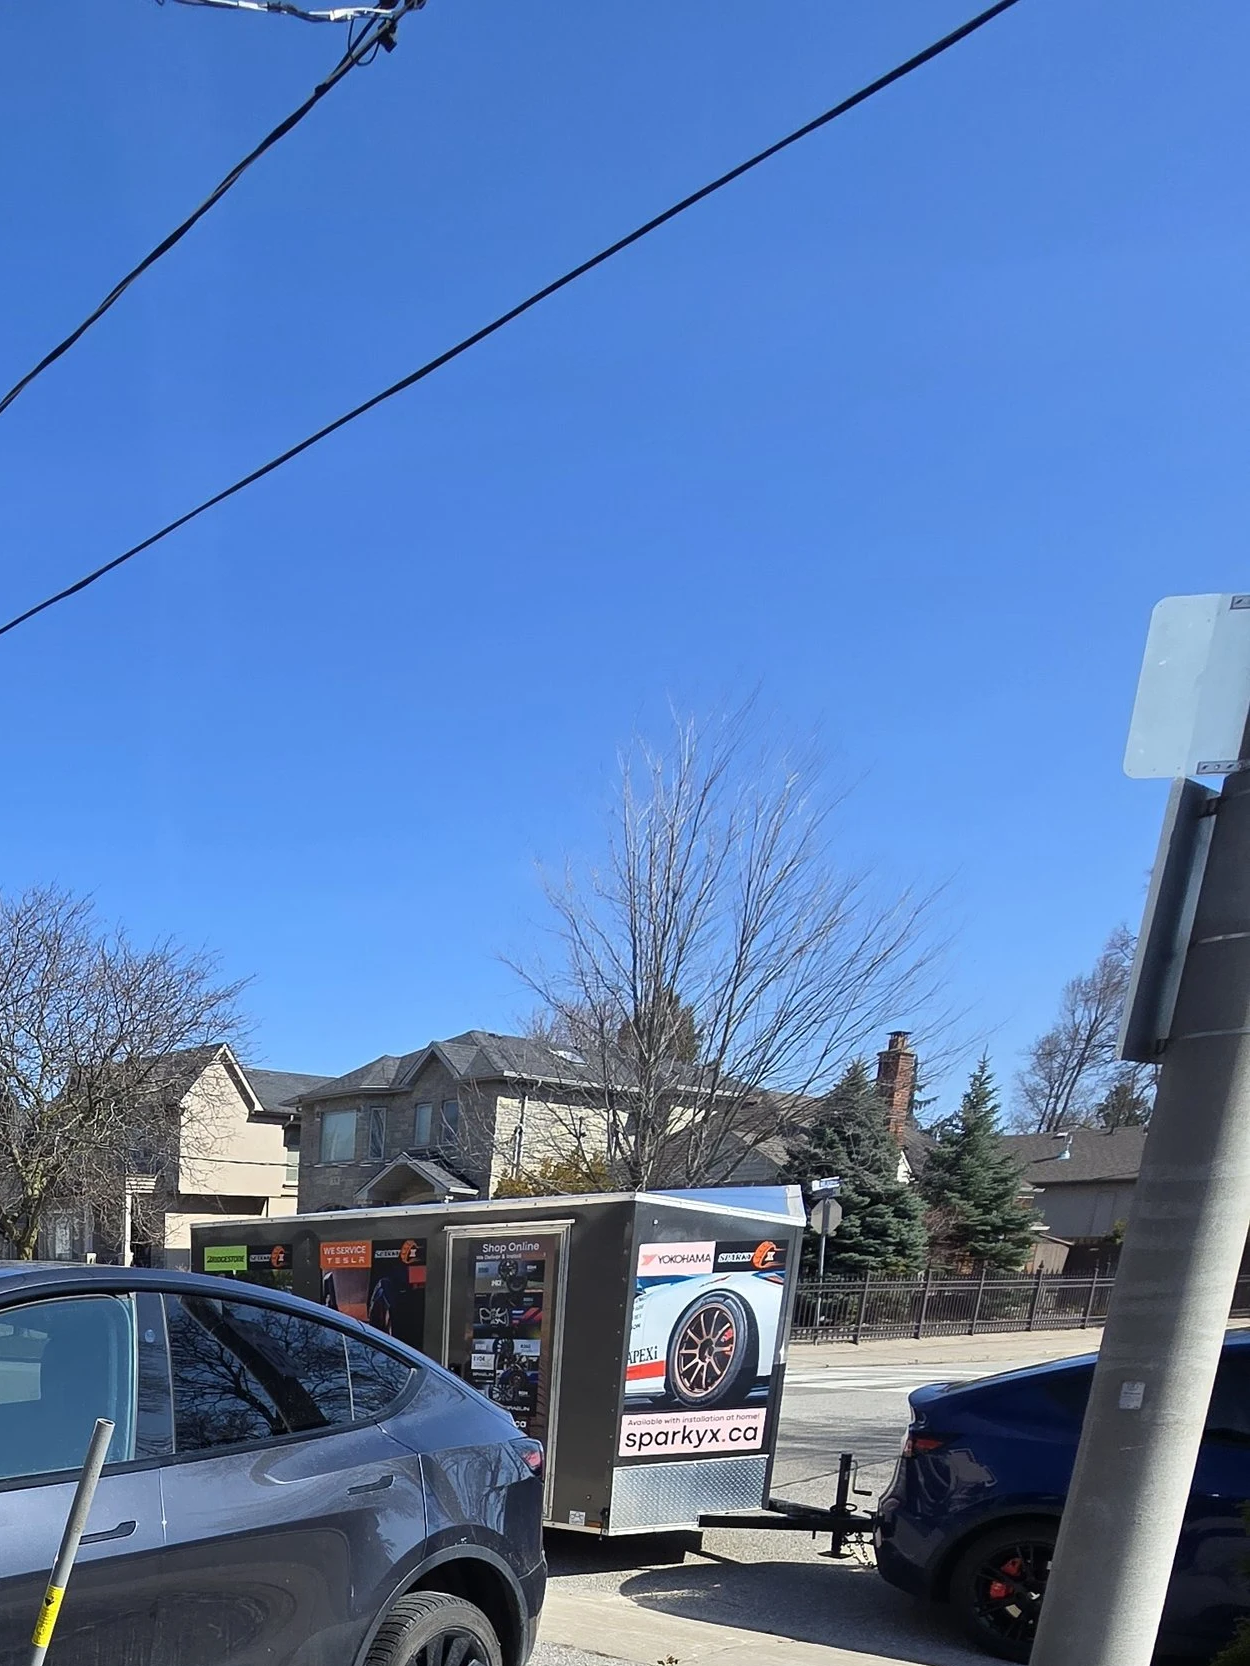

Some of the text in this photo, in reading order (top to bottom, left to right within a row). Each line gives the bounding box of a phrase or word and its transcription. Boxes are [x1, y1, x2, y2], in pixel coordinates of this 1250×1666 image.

[323, 1245, 366, 1255] WE SERVICE
[482, 1241, 540, 1253] Shop Online
[326, 1256, 366, 1264] TESLA
[657, 1253, 712, 1264] YOKOHAMA
[627, 1418, 663, 1426] Available
[681, 1414, 725, 1423] installation
[735, 1412, 761, 1420] home!
[624, 1424, 759, 1452] sparkyx.ca
